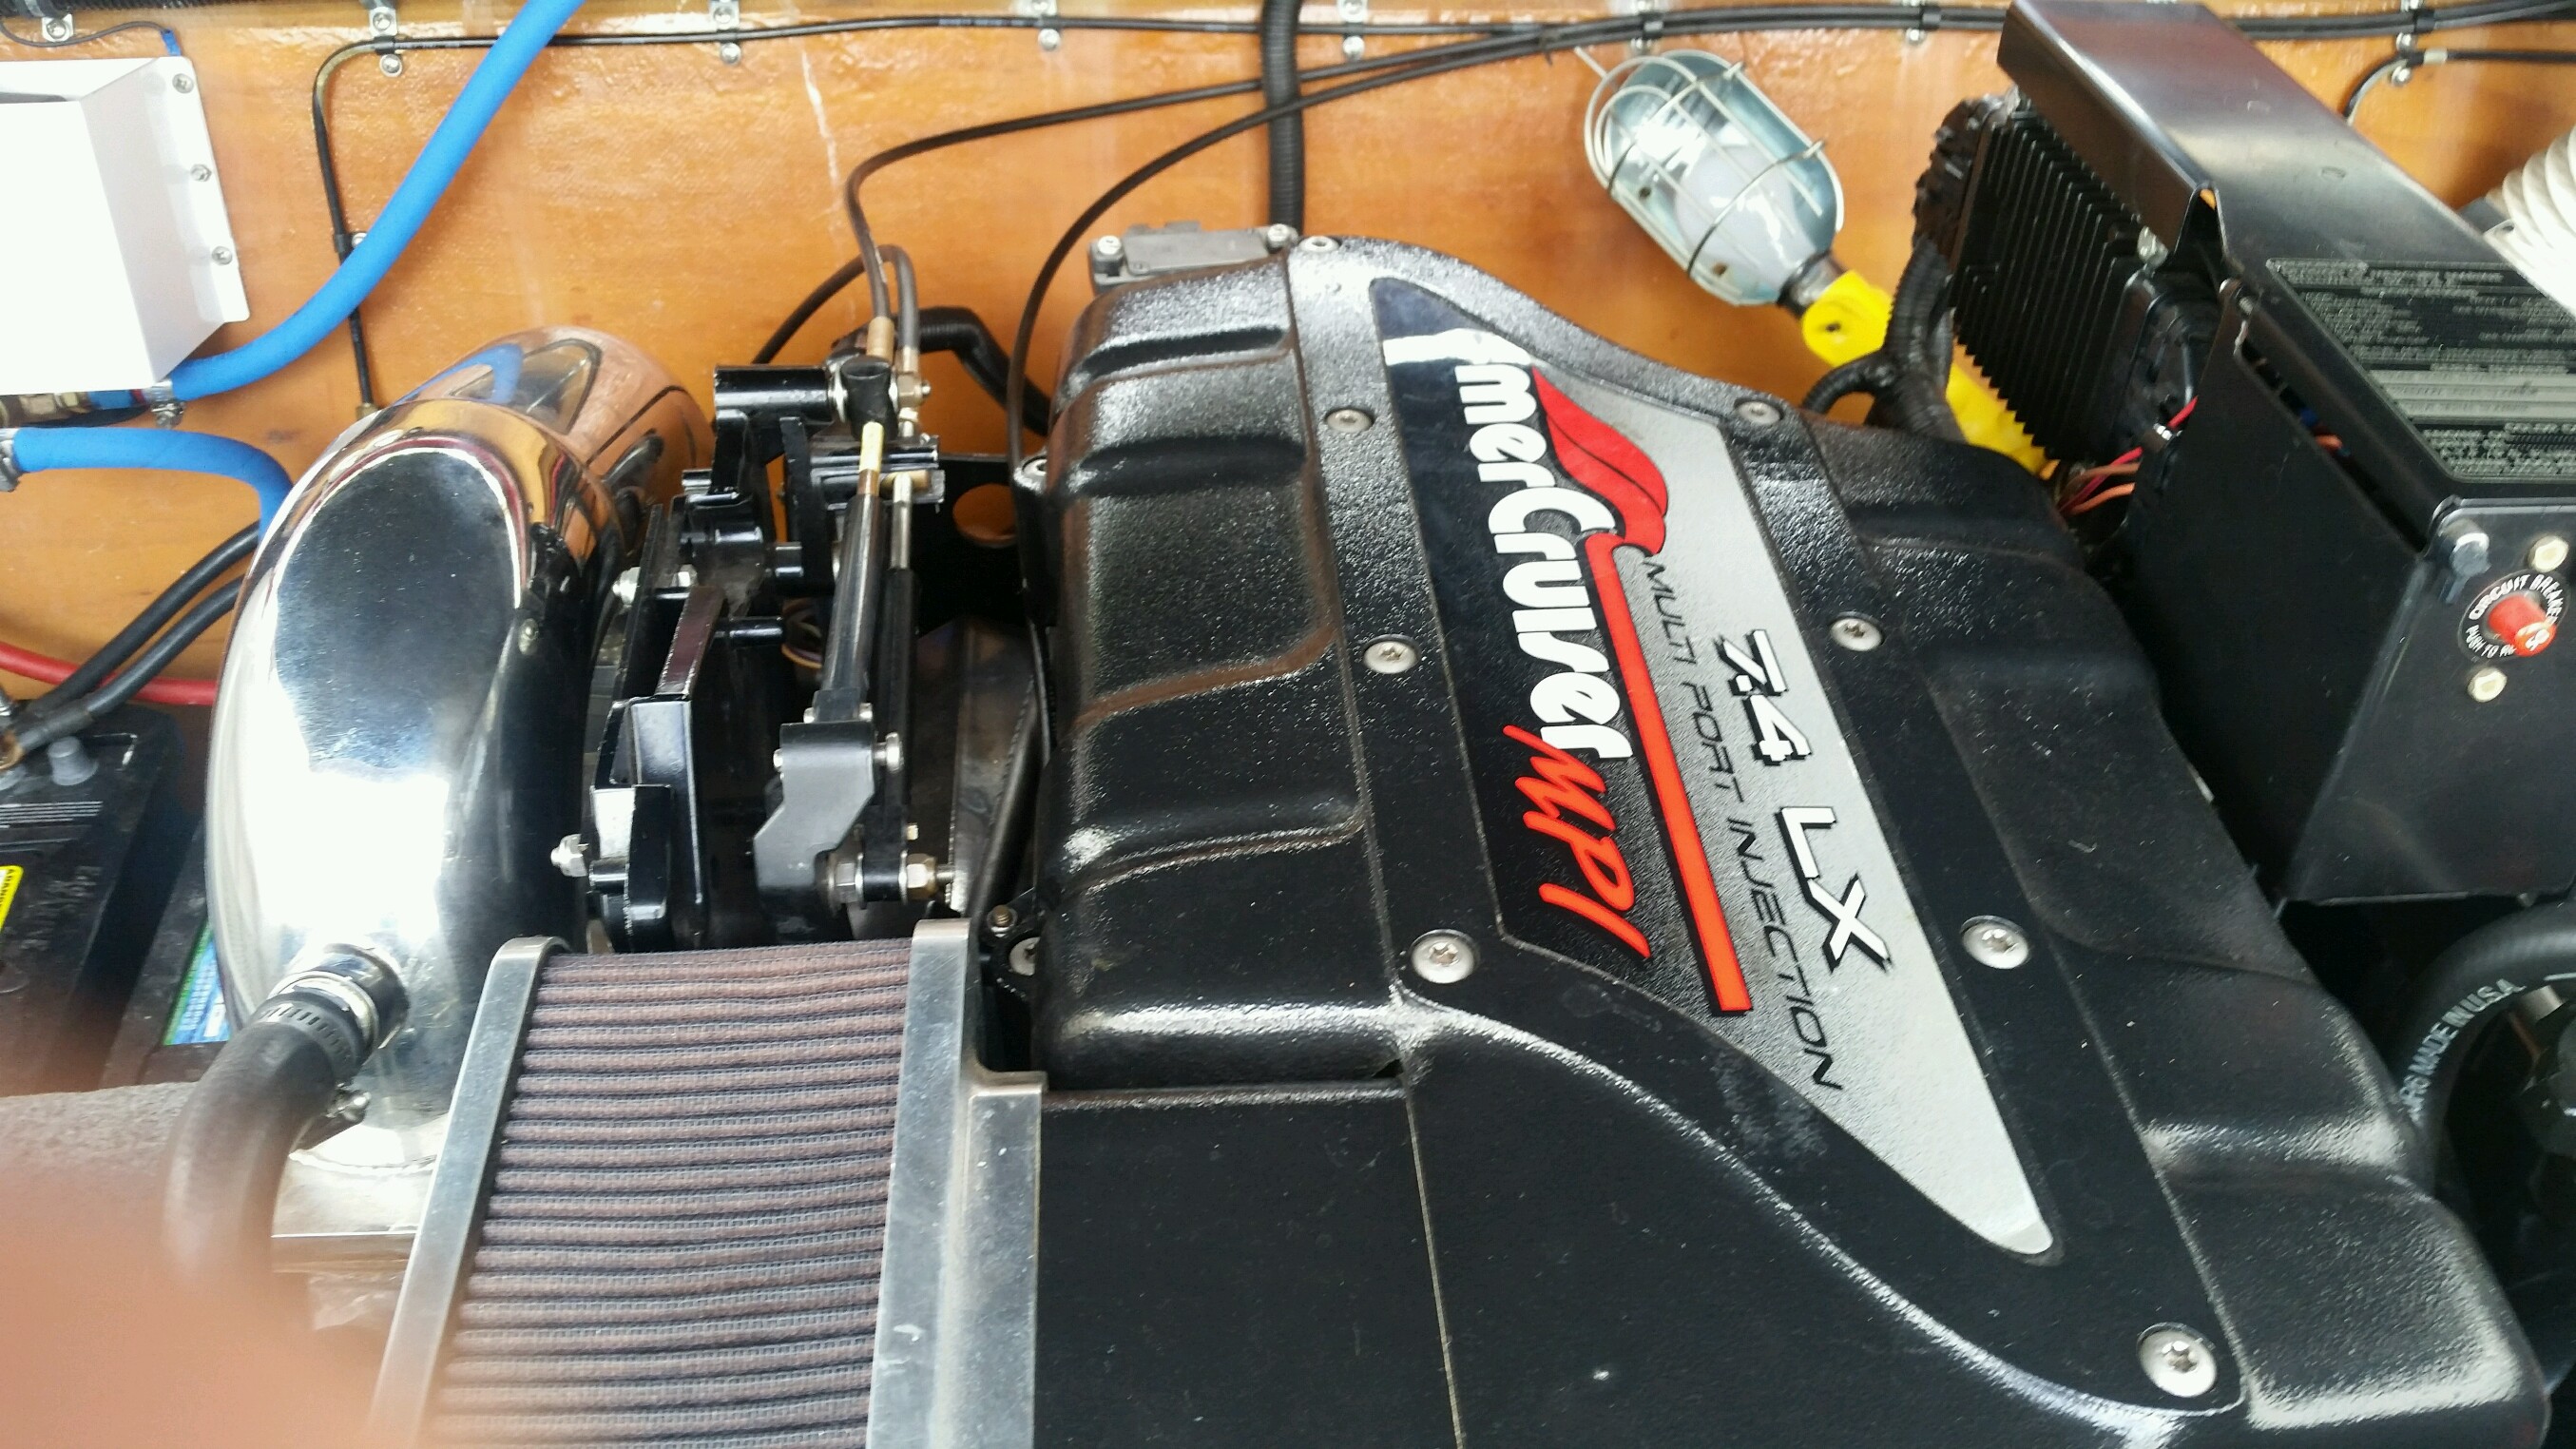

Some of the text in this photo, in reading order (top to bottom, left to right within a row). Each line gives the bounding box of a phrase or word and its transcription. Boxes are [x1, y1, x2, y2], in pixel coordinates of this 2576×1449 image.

[2469, 574, 2530, 620] CIRCUIT
[1503, 724, 1652, 960] MPI
[1644, 561, 1843, 1092] MULTI PORT INJECTION
[1715, 628, 1894, 974] 7.4 LX
[2408, 1021, 2460, 1075] MADE
